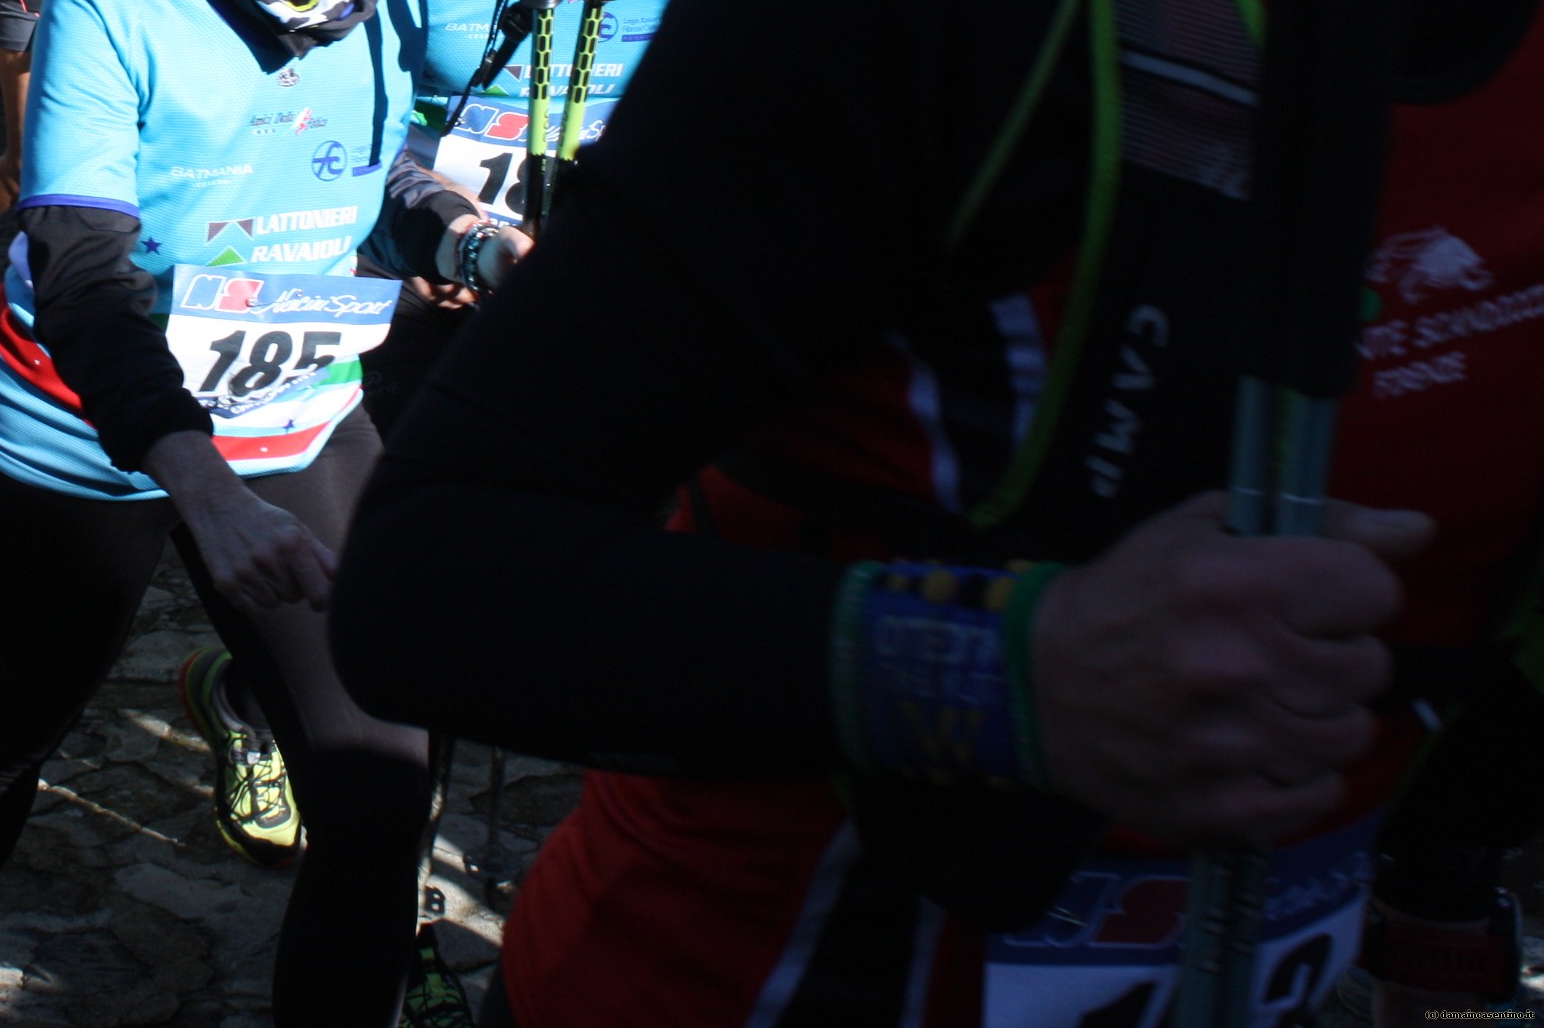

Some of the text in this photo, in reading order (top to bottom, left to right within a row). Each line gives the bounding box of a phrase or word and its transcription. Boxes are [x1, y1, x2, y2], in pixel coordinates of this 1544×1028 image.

[257, 205, 358, 235] LATTONIERI
[250, 235, 352, 263] RAVAIOLI
[328, 294, 393, 318] Sport
[199, 329, 342, 397] 185
[1083, 303, 1171, 500] CAMP
